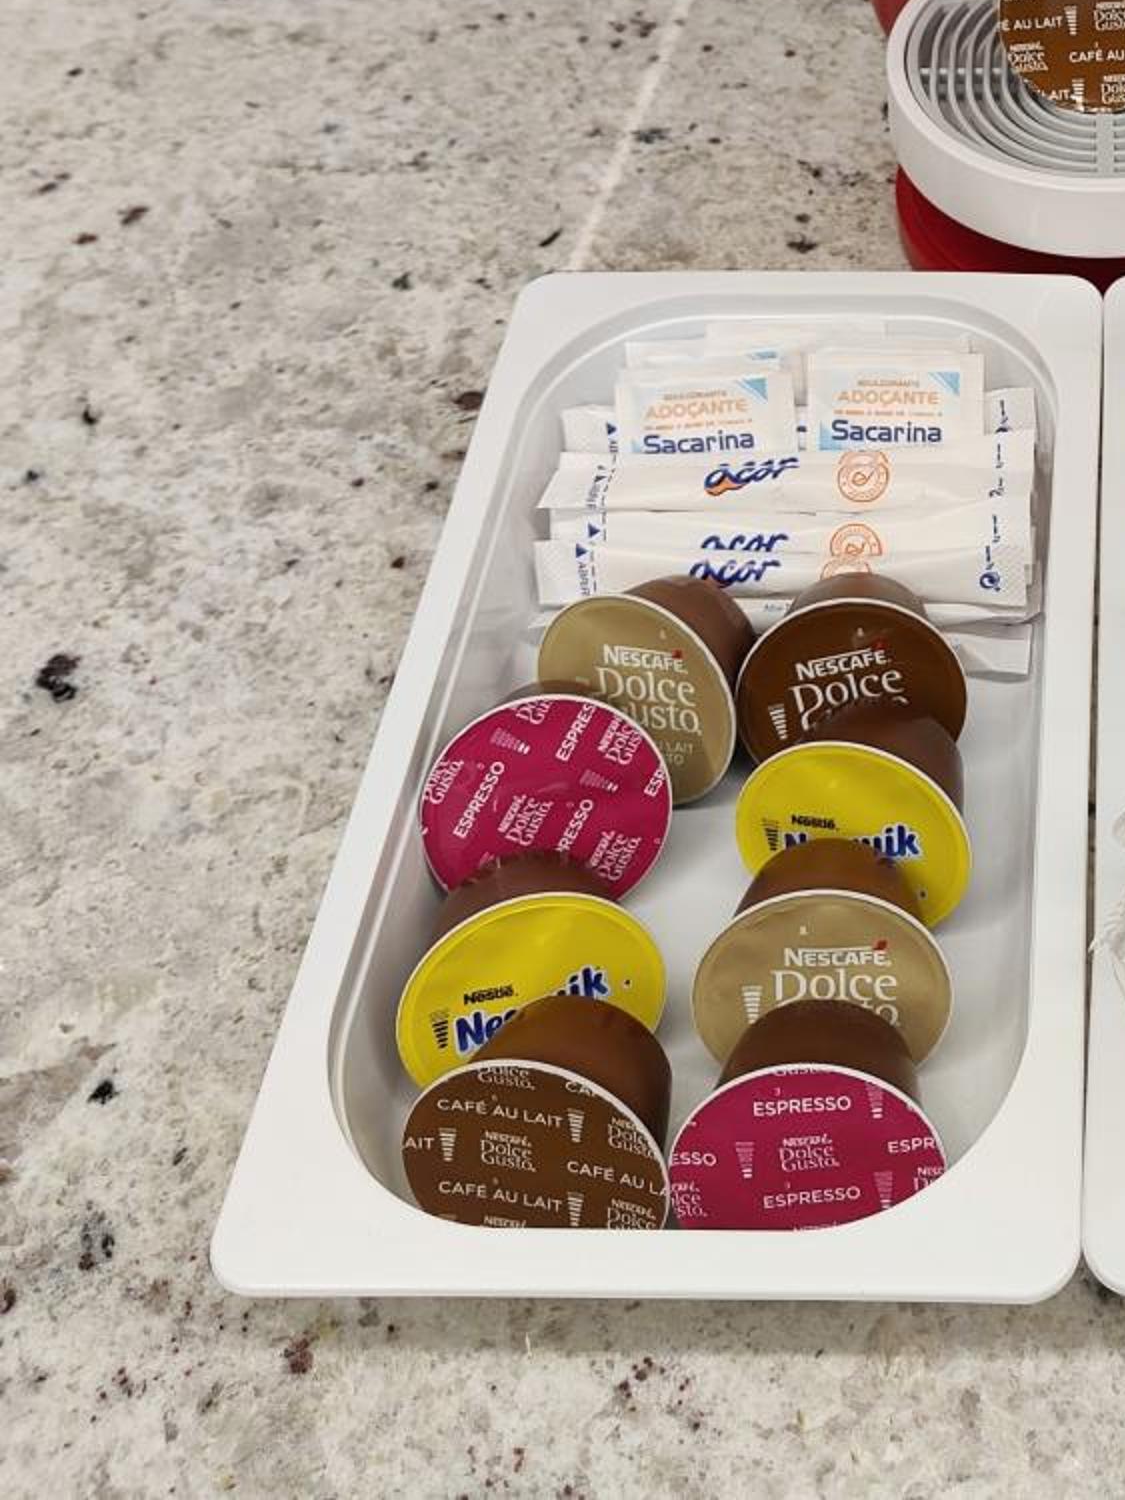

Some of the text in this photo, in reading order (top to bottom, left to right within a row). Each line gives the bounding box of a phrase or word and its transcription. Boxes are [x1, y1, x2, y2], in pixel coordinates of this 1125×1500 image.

[1014, 20, 1032, 31] AU
[1035, 16, 1063, 30] LAIT
[1107, 50, 1125, 62] AU
[645, 399, 748, 420] ADOÇANTE
[838, 389, 940, 408] ADOÇANTE
[643, 430, 755, 454] Sacarina
[832, 420, 942, 443] Sacarina
[594, 666, 697, 706] Dolce
[789, 669, 905, 714] Dolce
[622, 701, 702, 734] usto
[453, 761, 505, 839] ESPRESSO
[505, 797, 540, 842] Dolce
[518, 801, 554, 846] Gusto
[608, 836, 642, 882] Gusto
[770, 968, 897, 1007] Dolce
[478, 1072, 532, 1090] Gusto
[493, 1104, 518, 1119] AU
[524, 1110, 563, 1128] LAIT
[753, 1095, 851, 1117] ESPRESSO
[481, 1139, 532, 1159] Dolce
[779, 1145, 834, 1162] Dolce
[481, 1152, 534, 1172] Gusto
[780, 1158, 839, 1173] Gusto
[620, 1173, 645, 1190] AU
[493, 1188, 518, 1204] AU
[524, 1193, 563, 1213] LAIT
[763, 1186, 861, 1209] ESPRESSO
